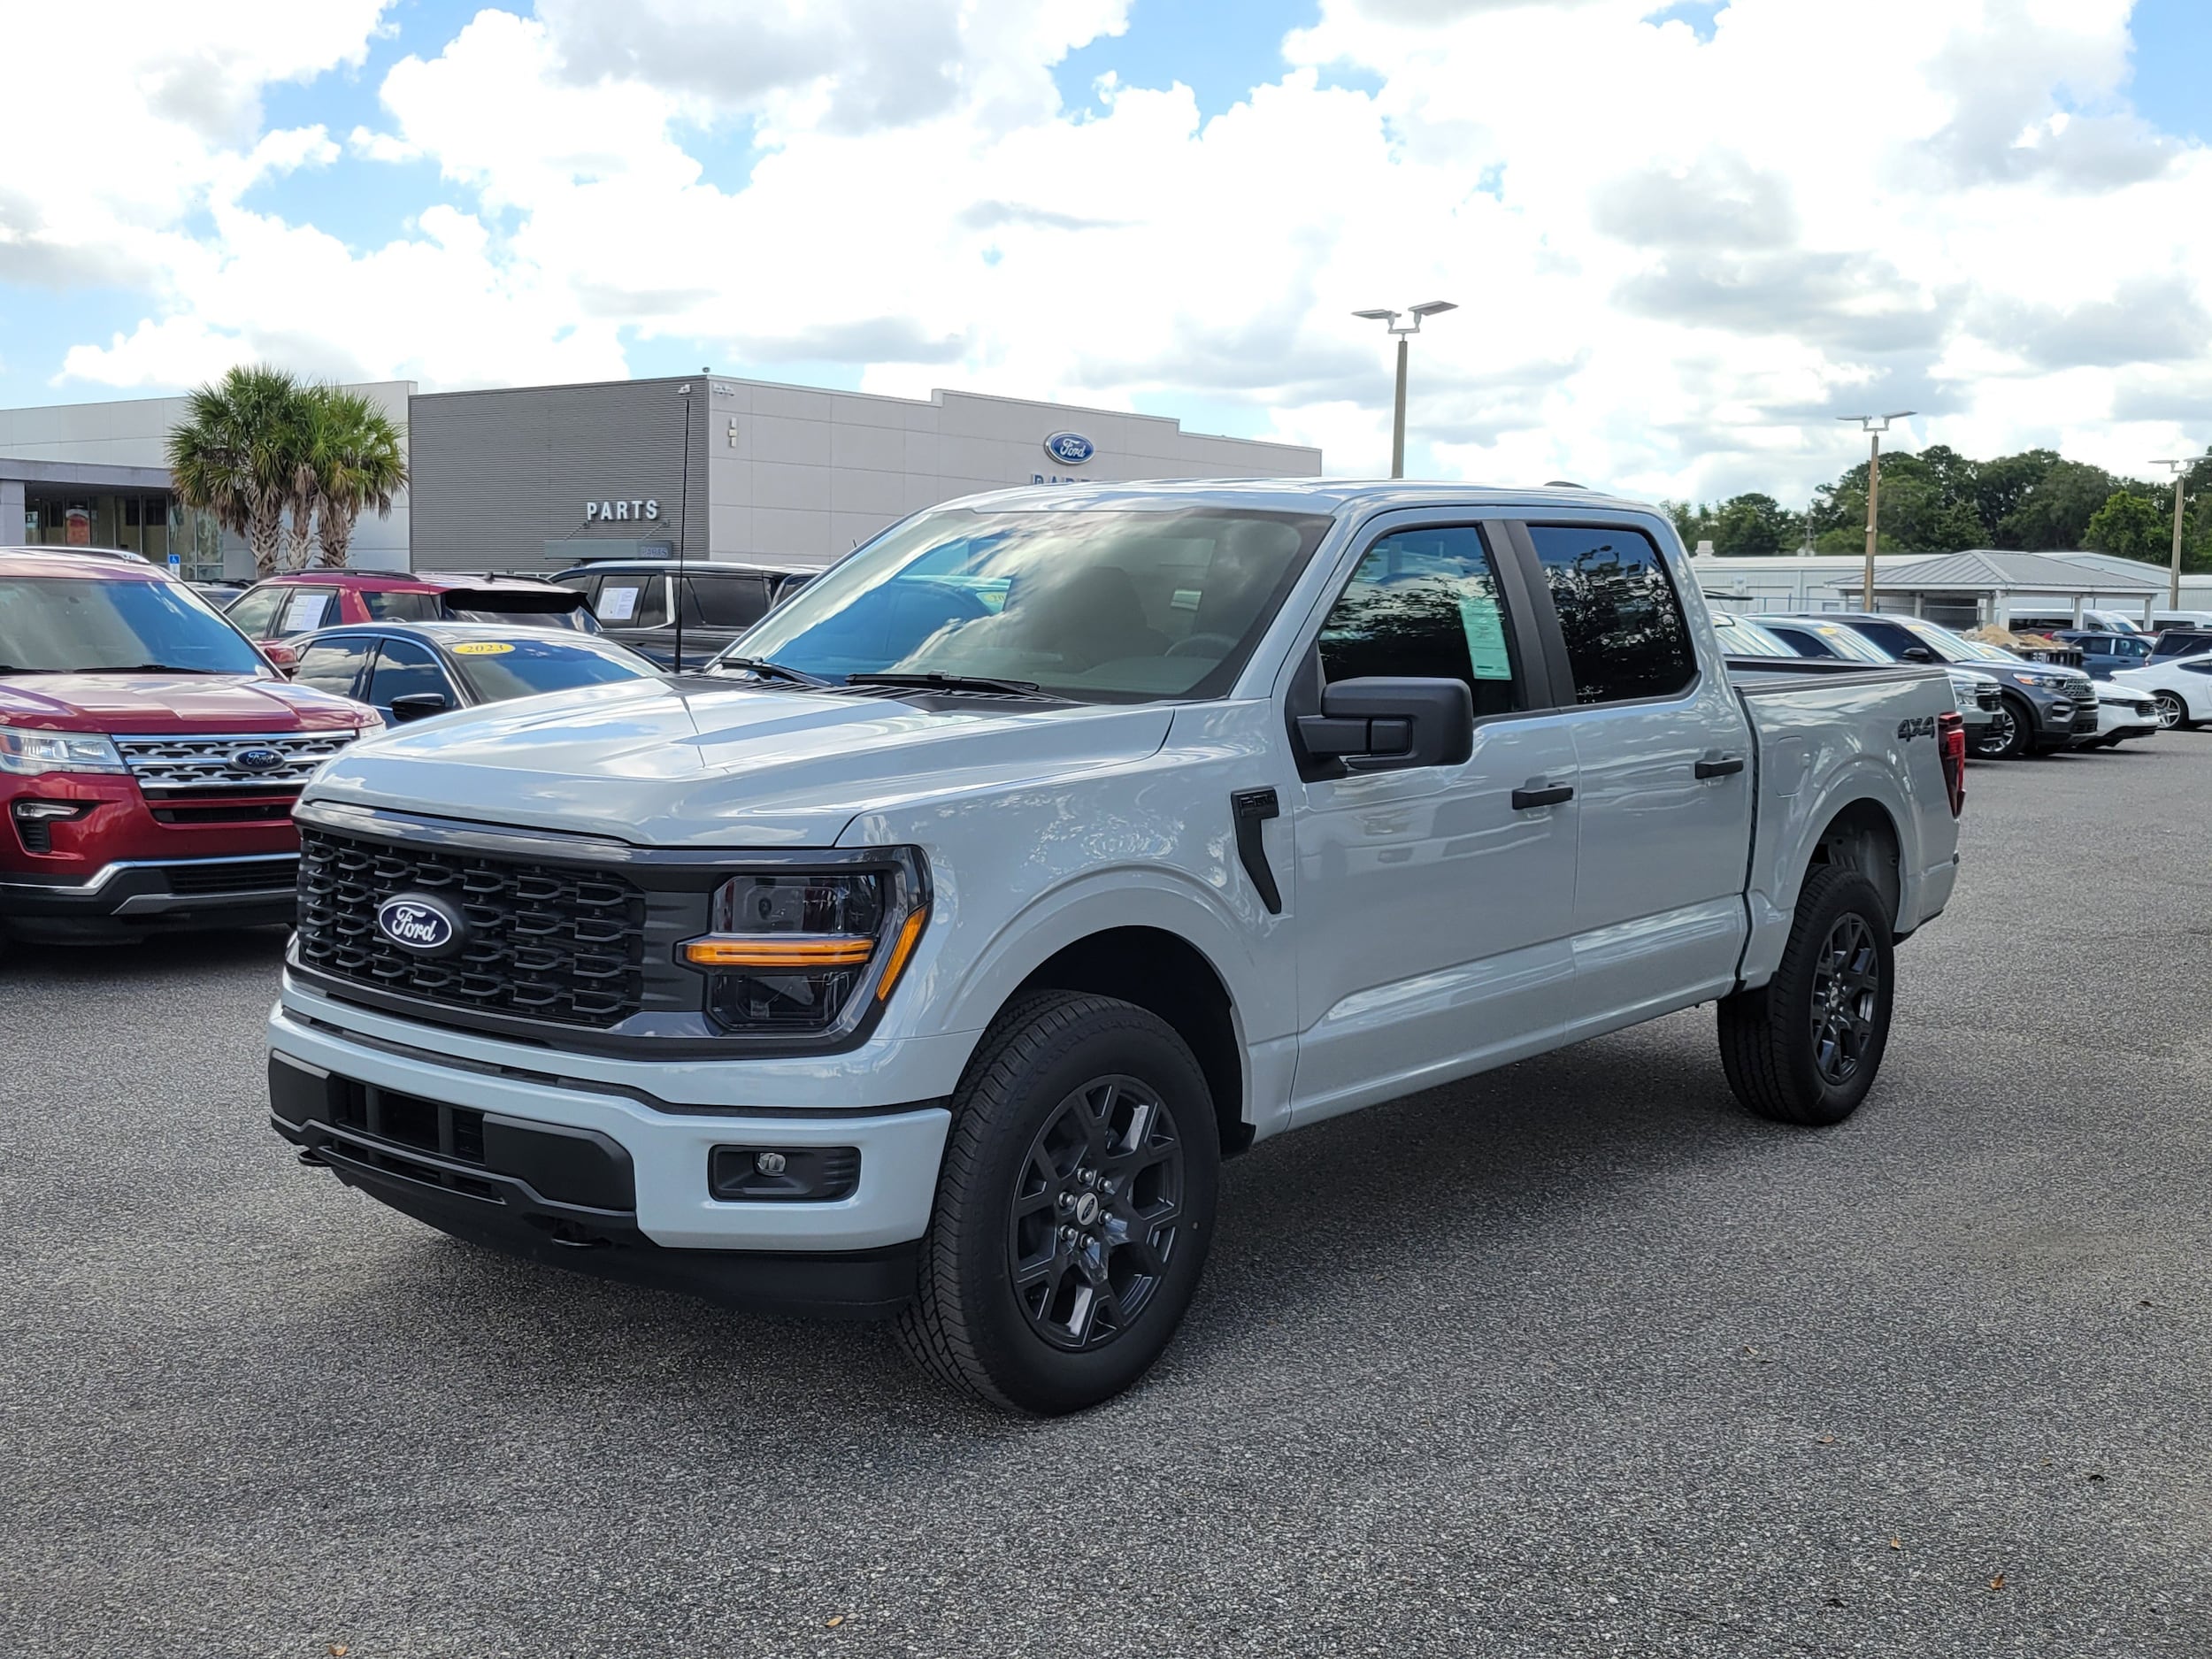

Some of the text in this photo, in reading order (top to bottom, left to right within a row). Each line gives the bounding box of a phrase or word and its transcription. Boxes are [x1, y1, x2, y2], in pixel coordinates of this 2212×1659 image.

[1060, 438, 1086, 457] Ford
[587, 499, 658, 521] PARTS
[466, 644, 504, 653] 2023
[246, 751, 274, 765] Ford
[392, 906, 438, 942] Ford
